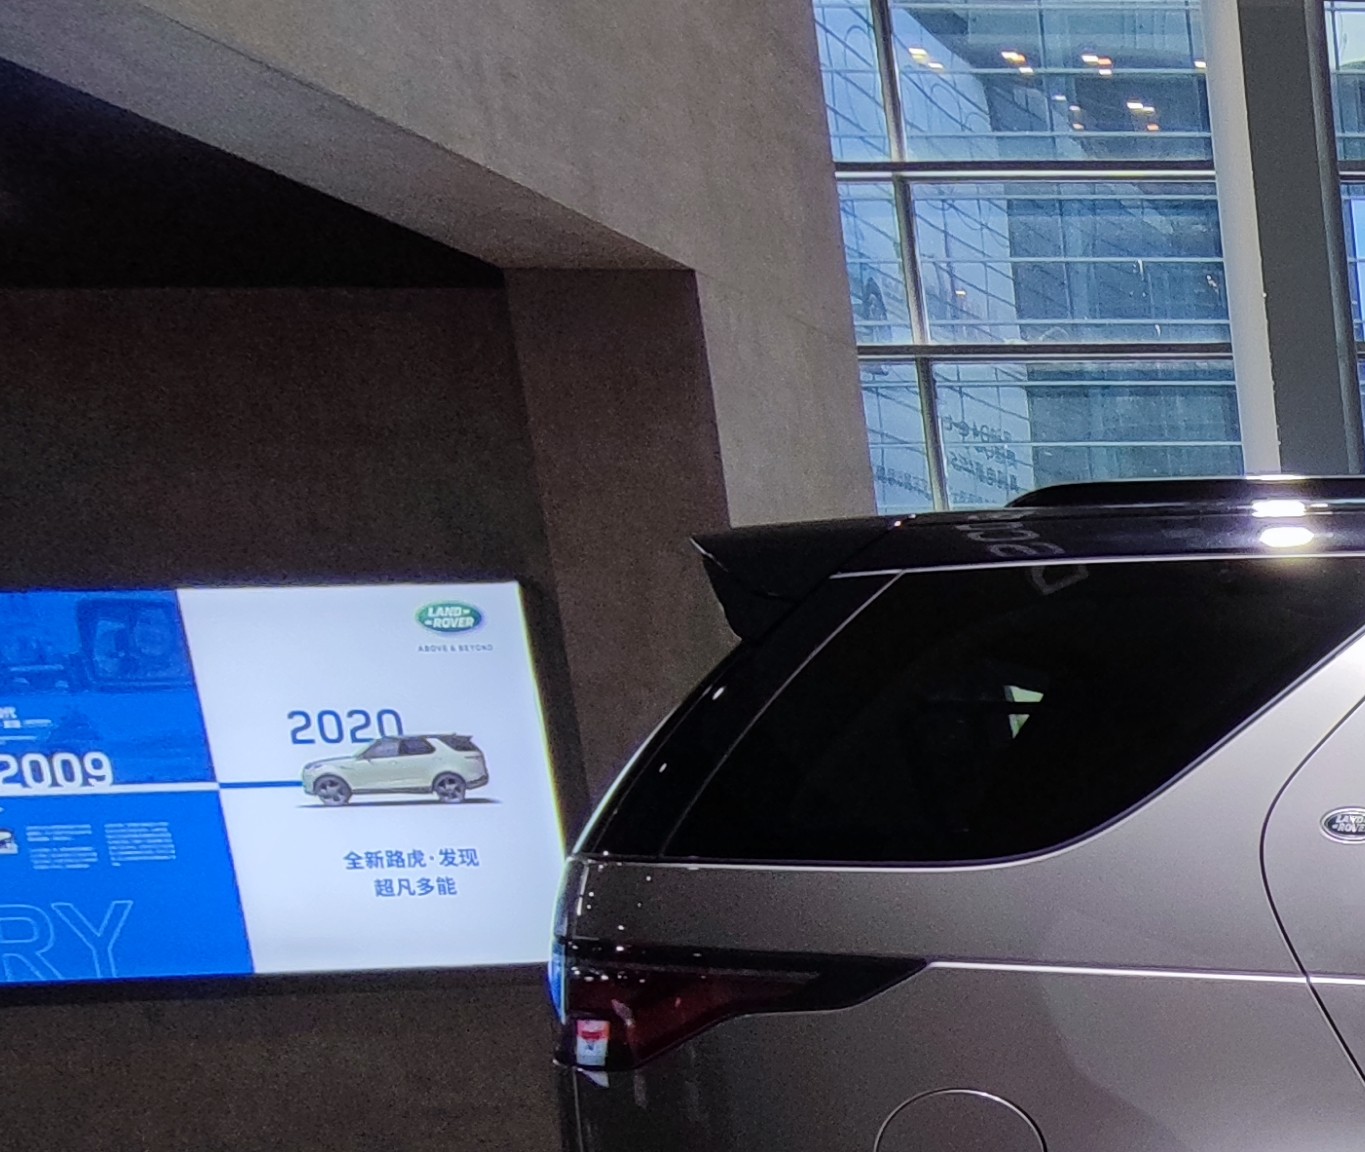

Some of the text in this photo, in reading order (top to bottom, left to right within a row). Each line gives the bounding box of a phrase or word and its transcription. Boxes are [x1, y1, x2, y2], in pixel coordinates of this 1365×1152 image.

[286, 708, 403, 745] 2020
[0, 751, 114, 789] 2009
[344, 848, 480, 870] 全新路虎·发现
[374, 877, 458, 897] 超凡多能
